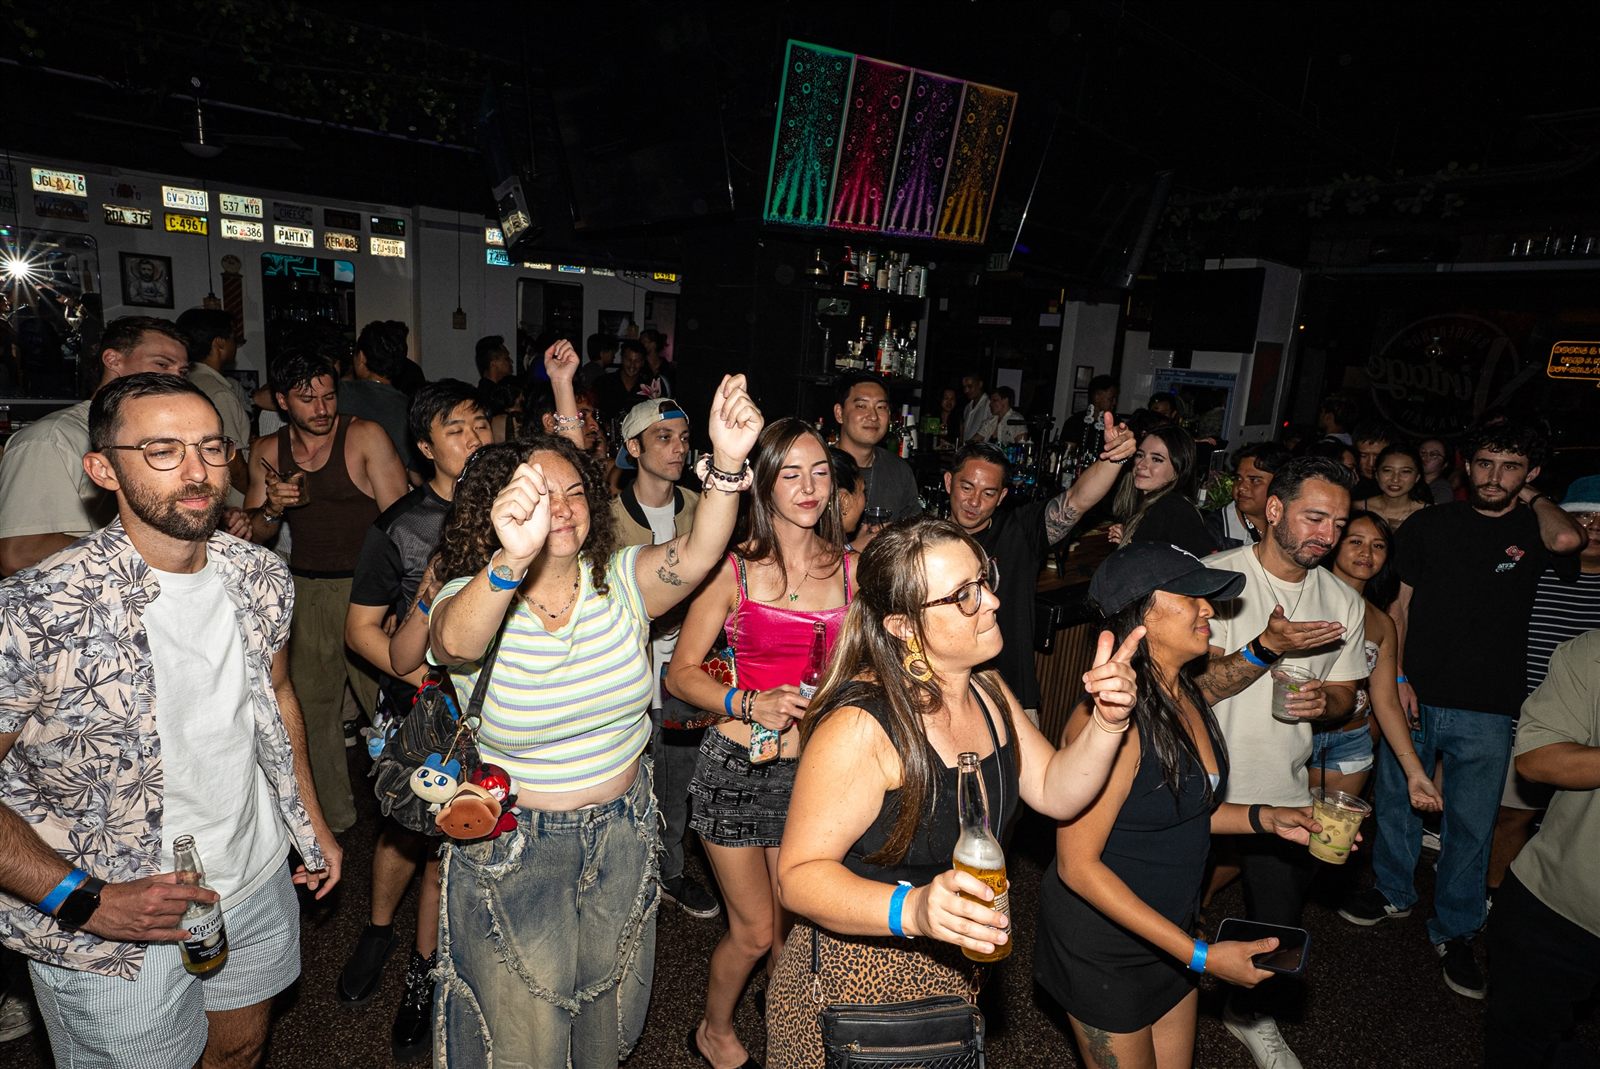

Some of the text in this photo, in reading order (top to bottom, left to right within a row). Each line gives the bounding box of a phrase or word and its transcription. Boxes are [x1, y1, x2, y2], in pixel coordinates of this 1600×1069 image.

[35, 175, 85, 191] JGL 216
[223, 201, 239, 212] 537
[131, 212, 151, 225] 375
[226, 225, 262, 238] MG 386
[278, 230, 309, 243] PAHTAY
[325, 236, 341, 248] KER
